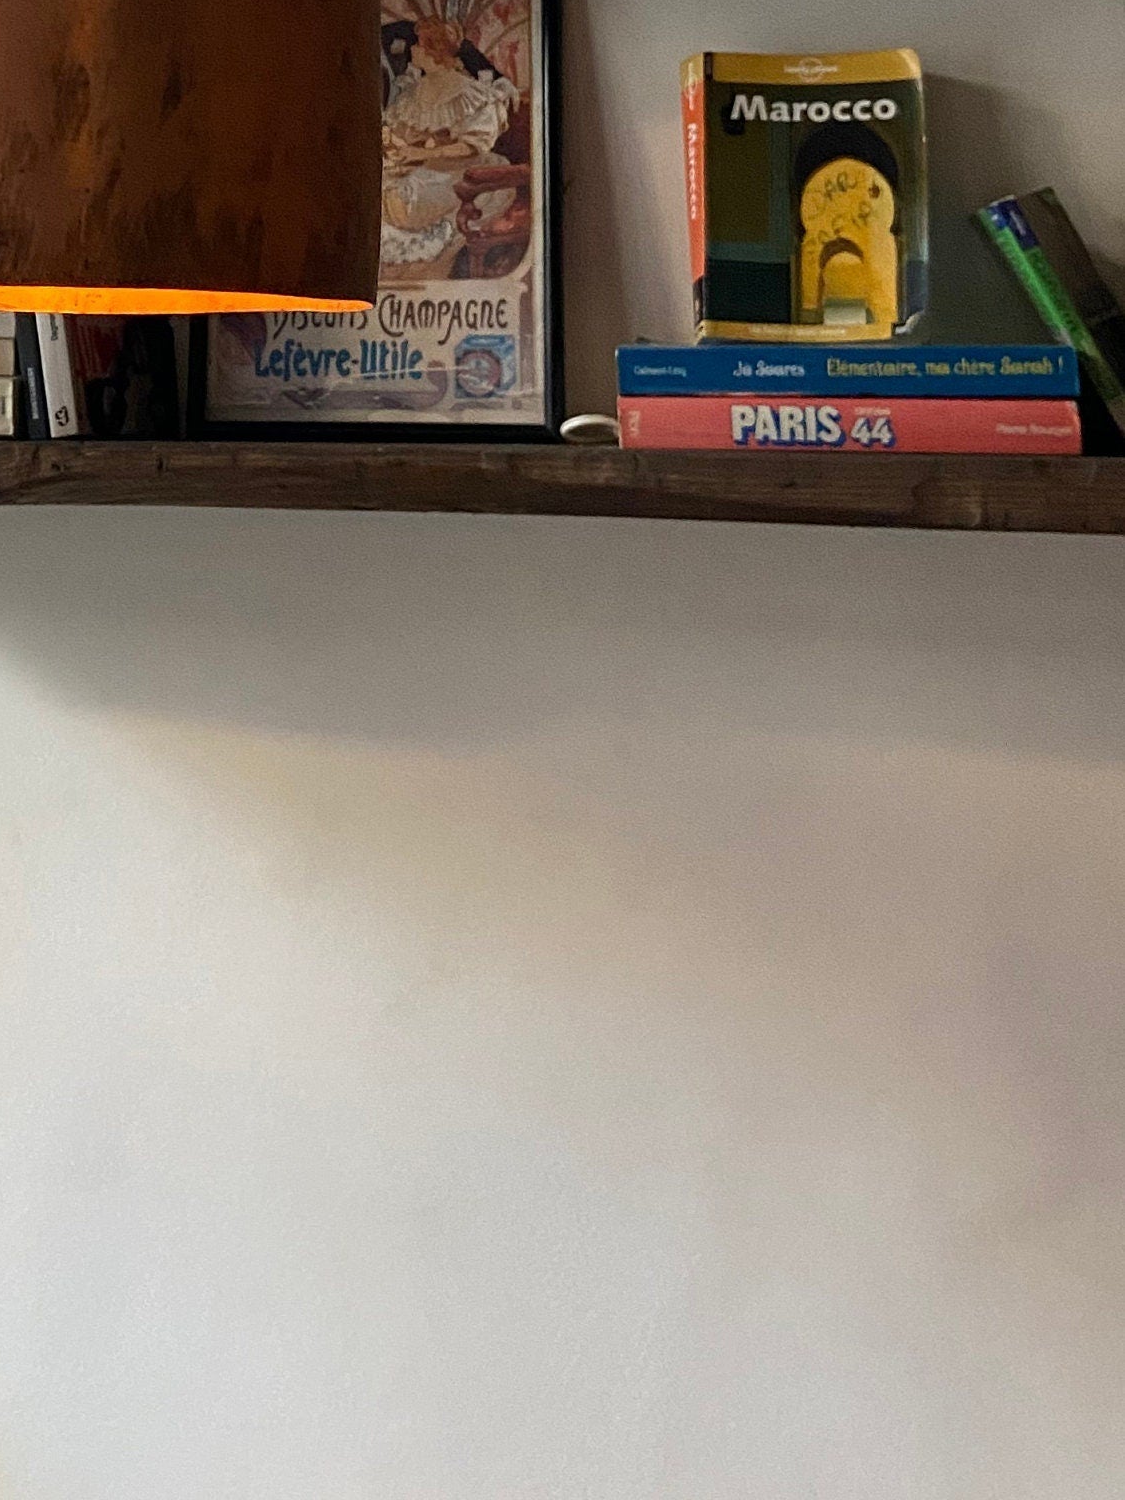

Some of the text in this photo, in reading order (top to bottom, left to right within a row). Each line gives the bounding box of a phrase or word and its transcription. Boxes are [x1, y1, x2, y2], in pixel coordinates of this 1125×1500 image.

[731, 93, 898, 123] Marocco
[378, 294, 508, 345] CHAMPAGNE
[254, 338, 423, 381] Lefèvre-Utile
[731, 404, 844, 446] PARIS
[850, 417, 894, 446] 44
